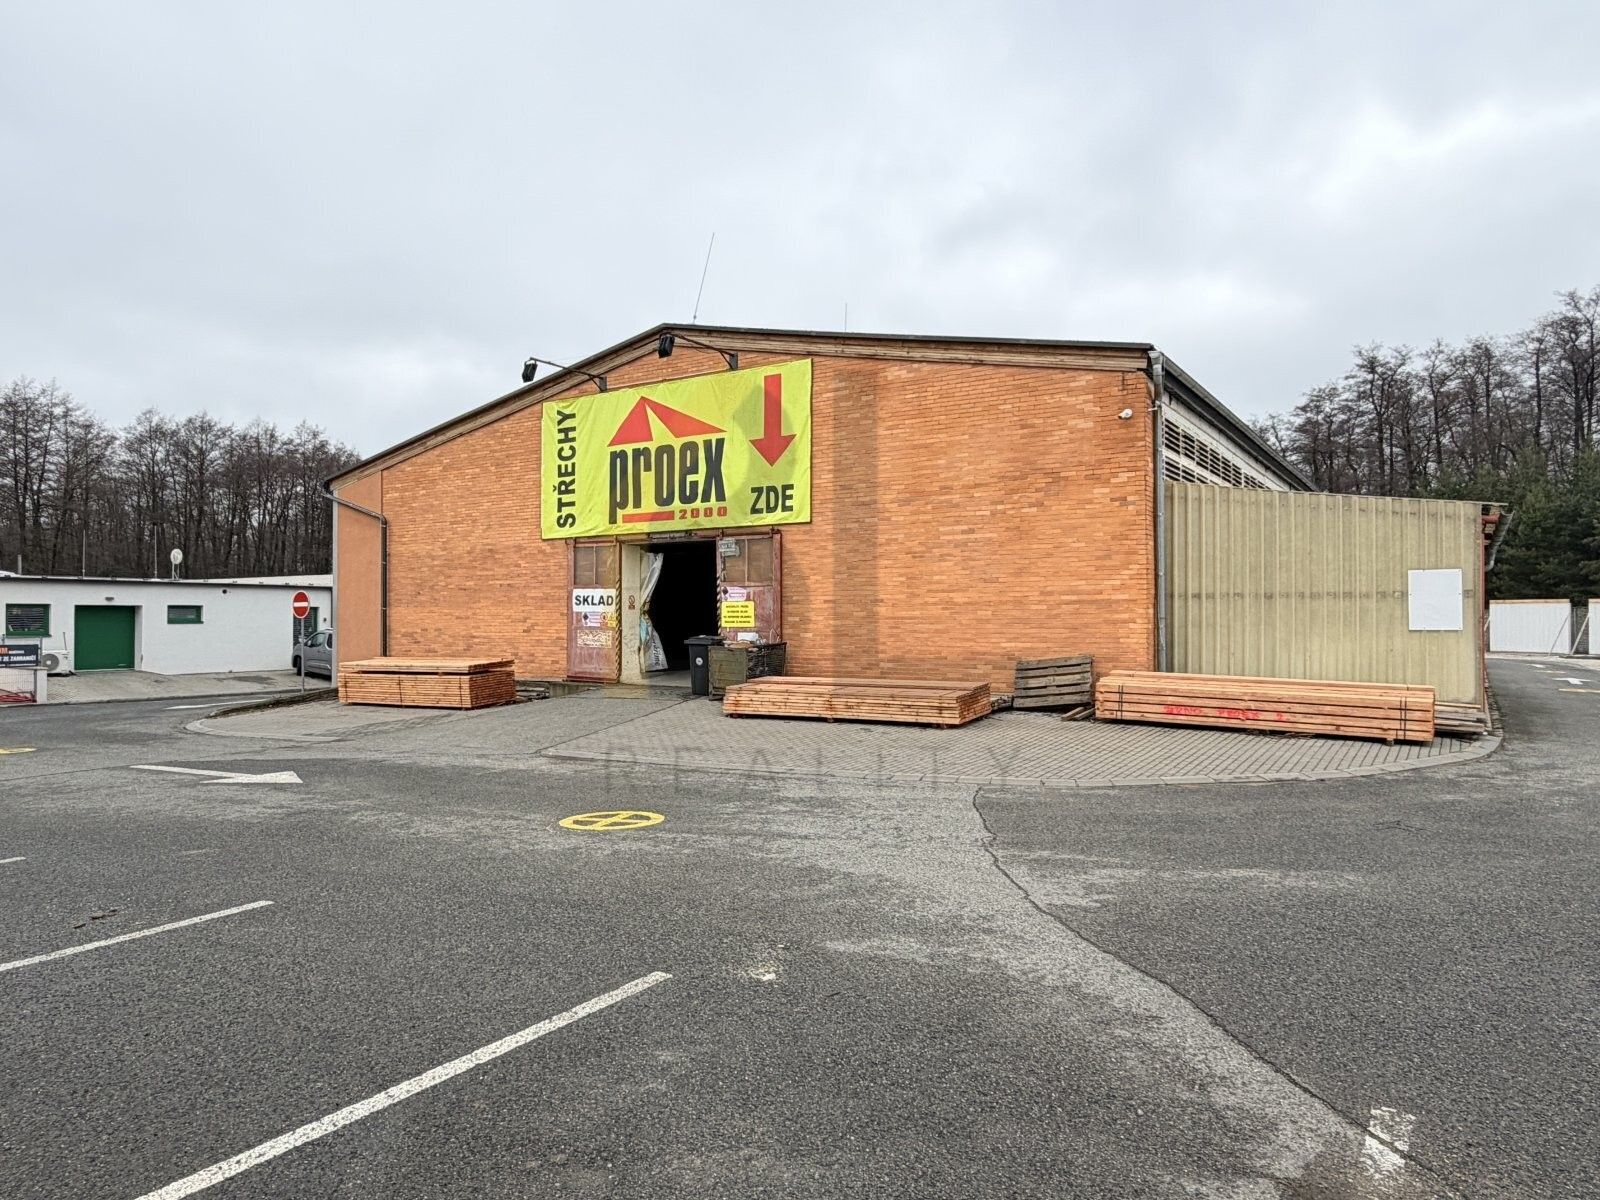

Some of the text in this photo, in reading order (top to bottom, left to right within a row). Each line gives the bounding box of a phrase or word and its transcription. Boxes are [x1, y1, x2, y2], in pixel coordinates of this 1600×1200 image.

[553, 409, 577, 529] STŘECHY
[609, 437, 728, 525] proex
[678, 506, 728, 521] 2000
[749, 483, 795, 516] ZDE
[574, 594, 614, 607] SKLAD
